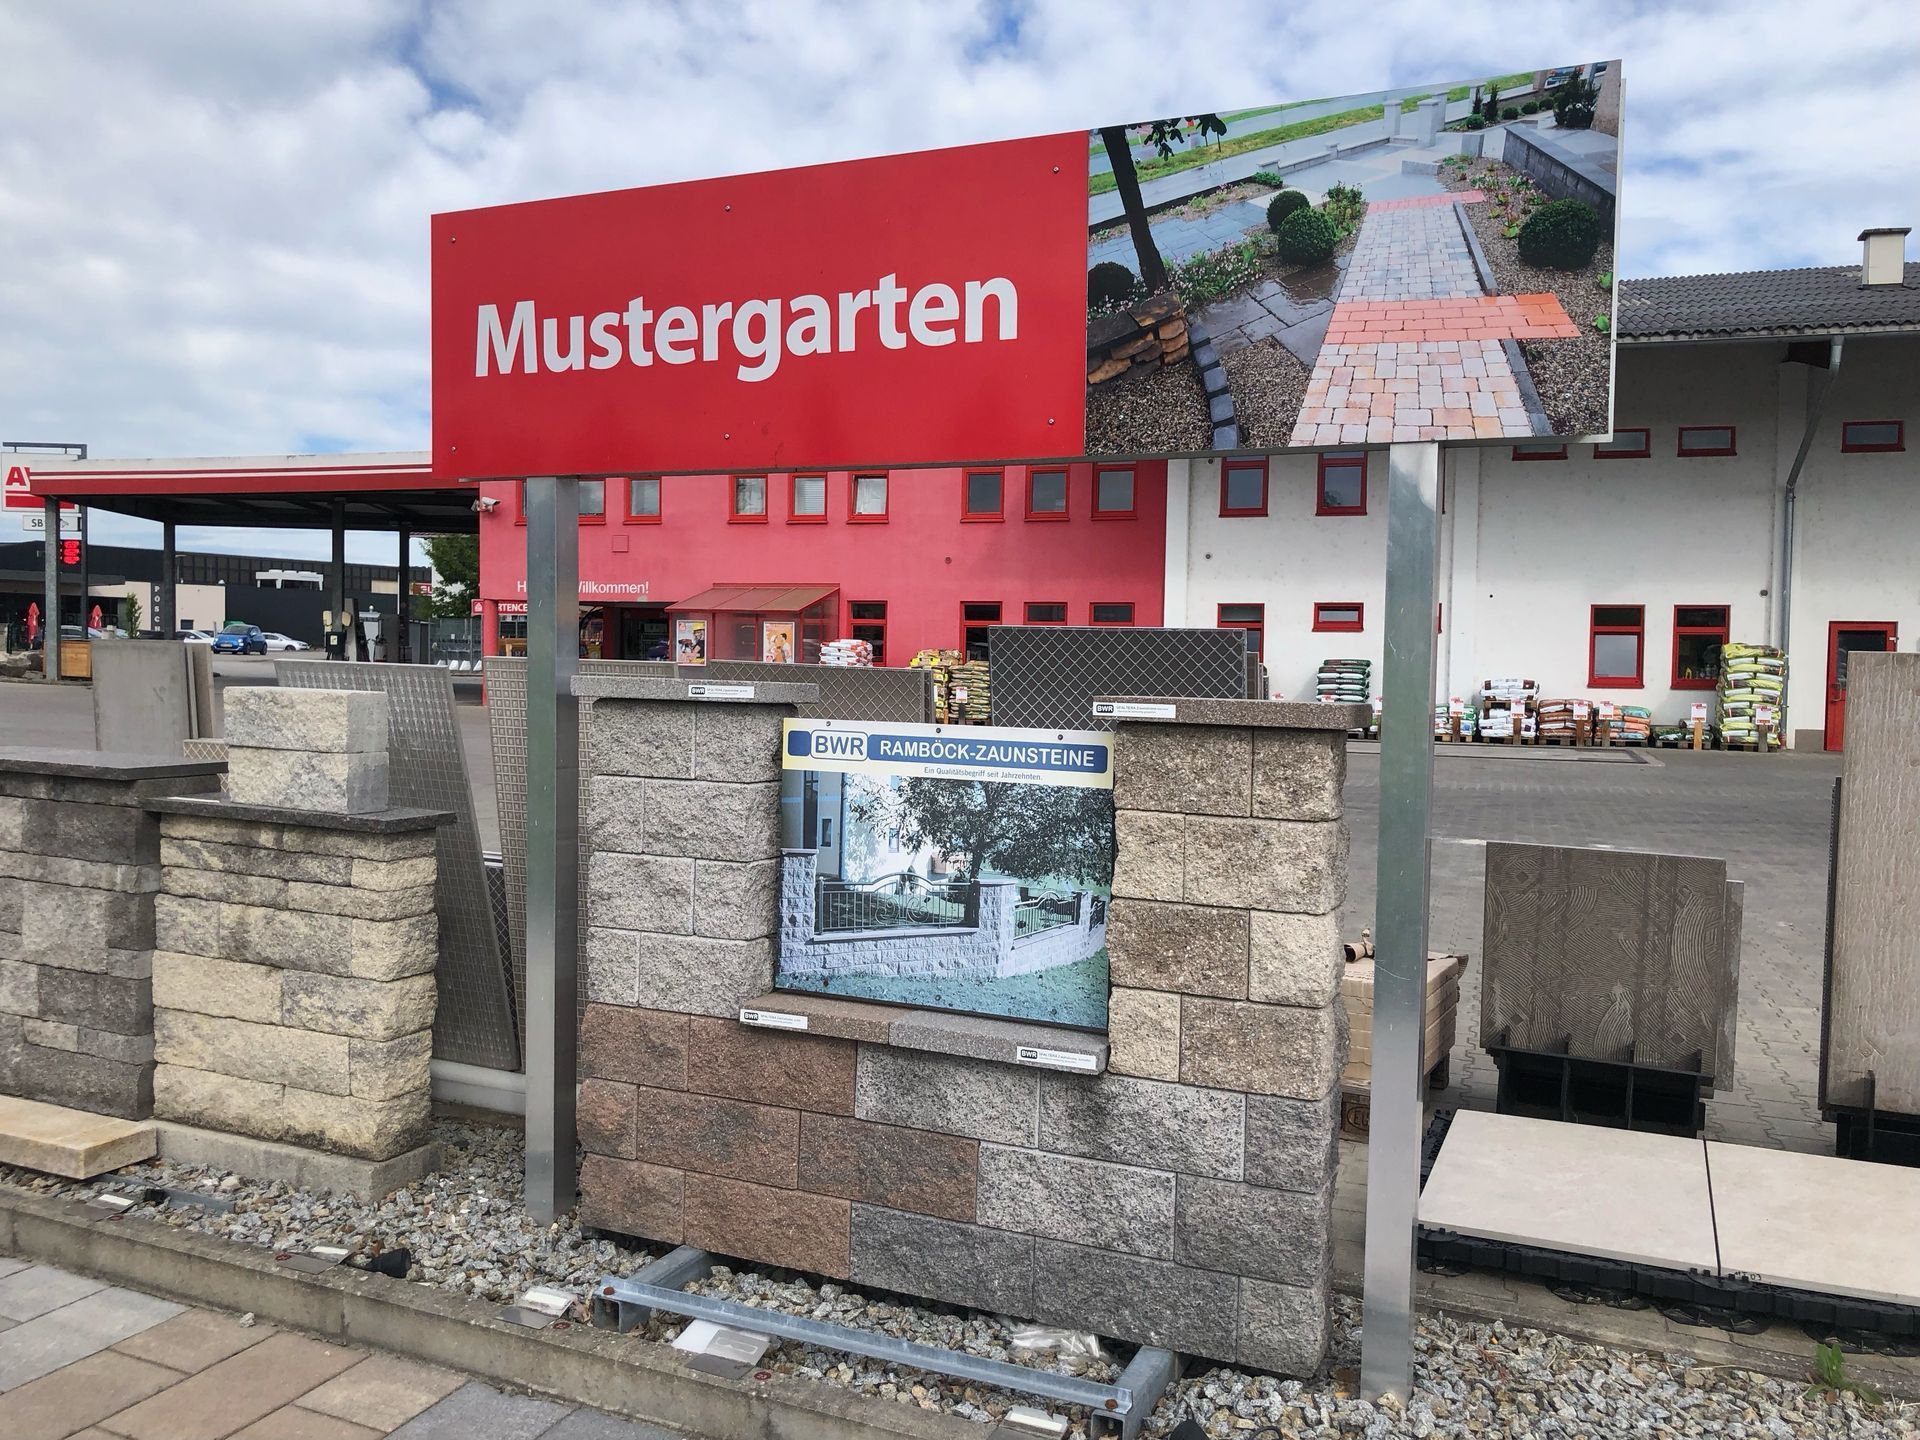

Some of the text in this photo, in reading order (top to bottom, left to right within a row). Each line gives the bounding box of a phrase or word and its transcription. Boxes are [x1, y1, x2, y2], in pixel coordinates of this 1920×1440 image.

[475, 273, 1019, 383] Mustergarten
[6, 466, 30, 486] A
[517, 580, 528, 593] H
[498, 603, 528, 612] RTENCE
[1097, 704, 1114, 713] BWR
[815, 735, 1095, 767] BWR RAMBÖCK-ZAUNSTEINE
[924, 766, 1043, 781] Ein Qualitätsbegriff seit Jahrzehnten.
[1021, 1049, 1037, 1059] BWR
